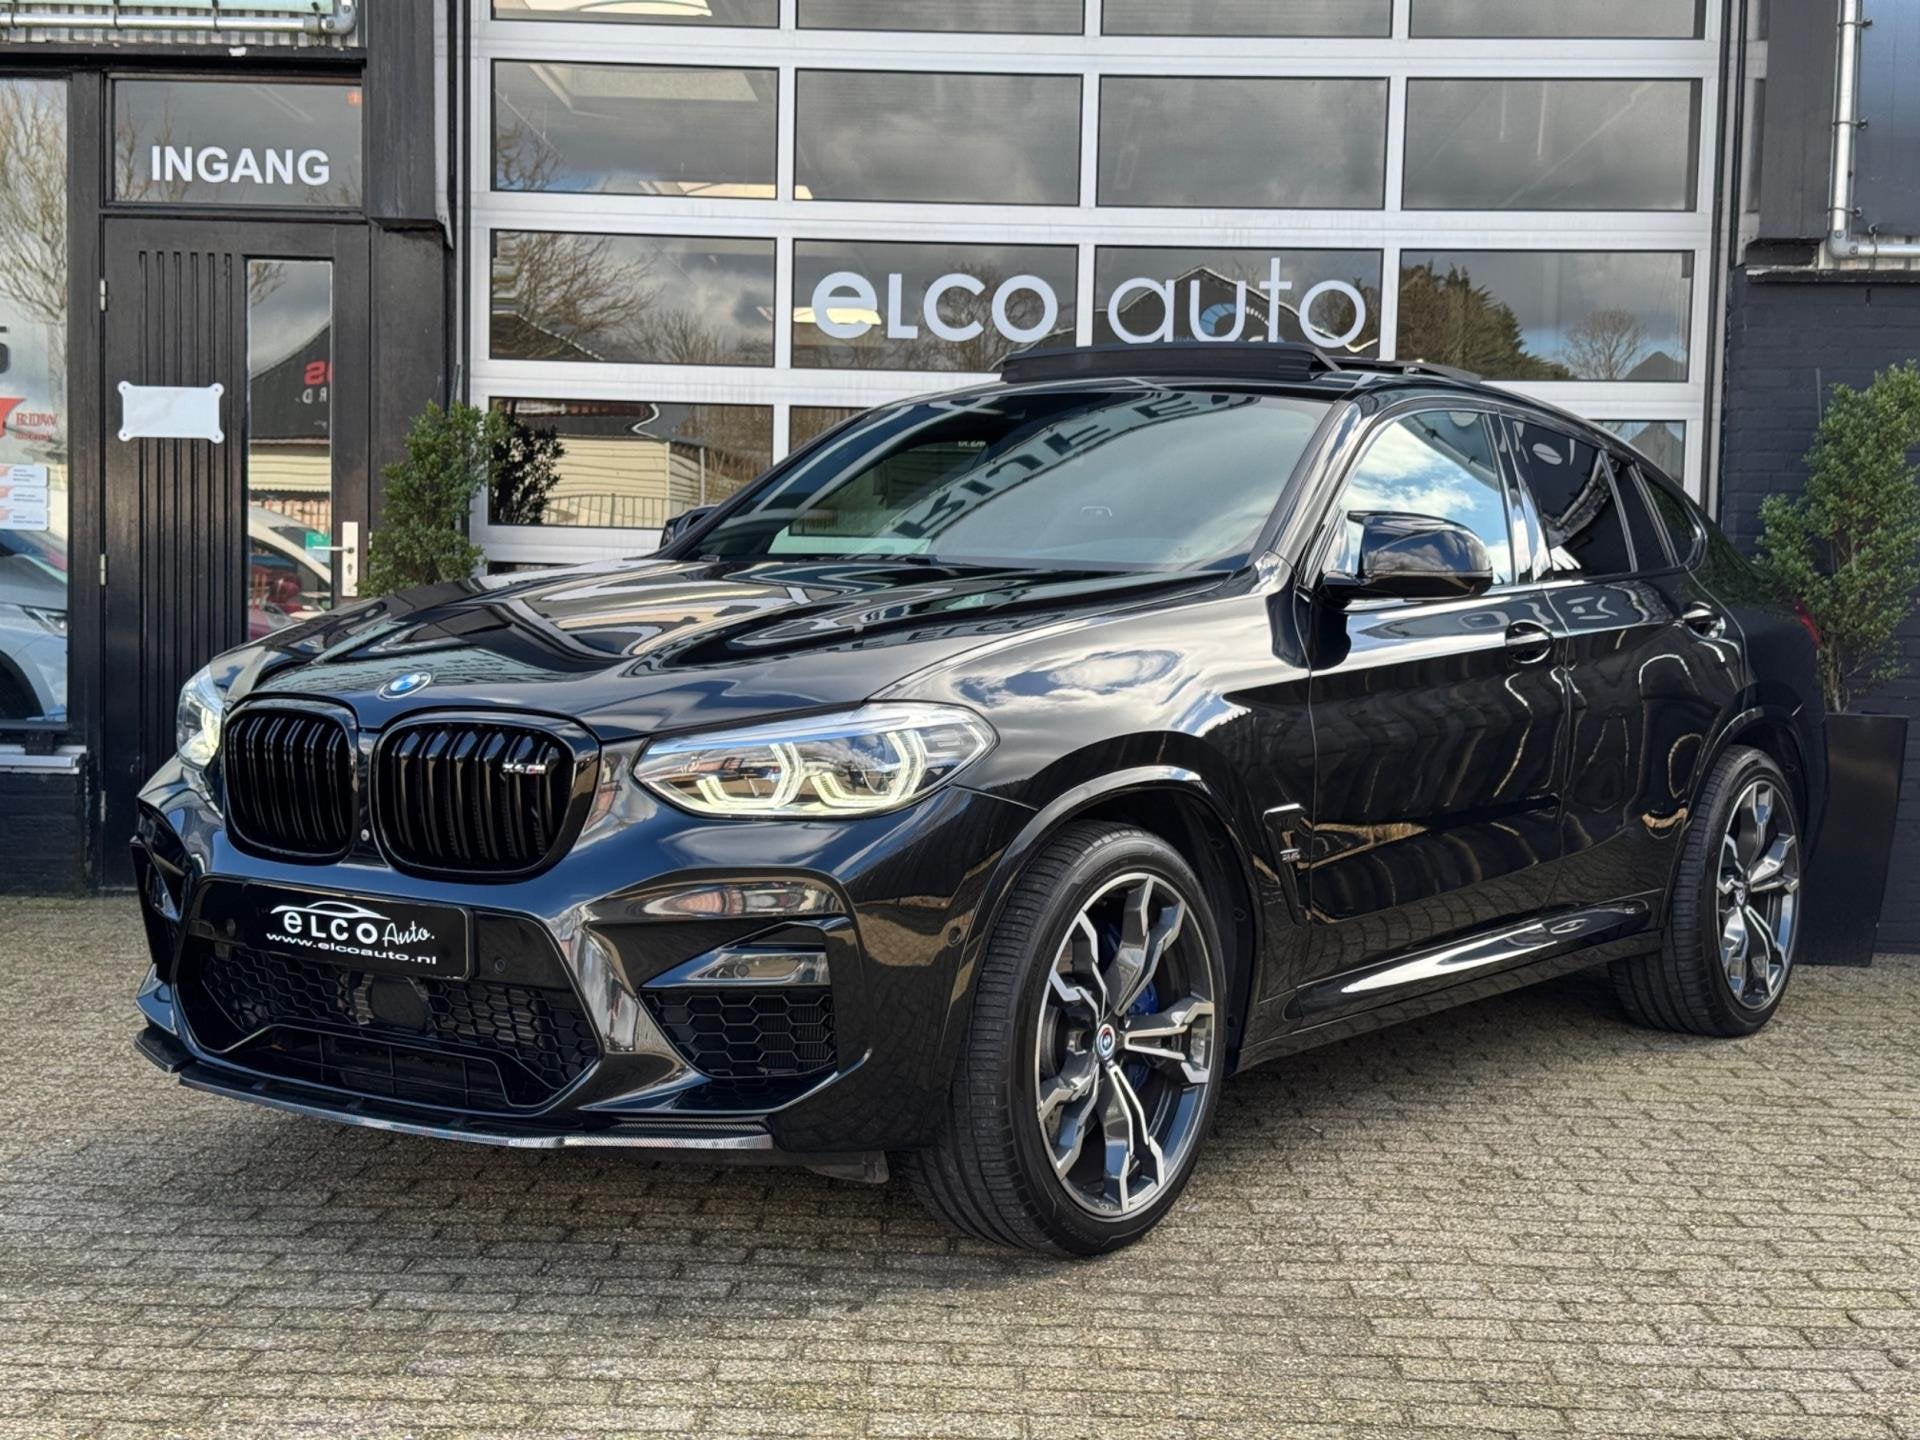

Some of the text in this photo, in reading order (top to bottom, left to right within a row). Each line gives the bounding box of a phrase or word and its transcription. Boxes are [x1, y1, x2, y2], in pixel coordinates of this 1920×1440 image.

[151, 145, 331, 186] INGANG
[1108, 257, 1366, 349] auto
[266, 933, 437, 965] www.elcoauto.nl
